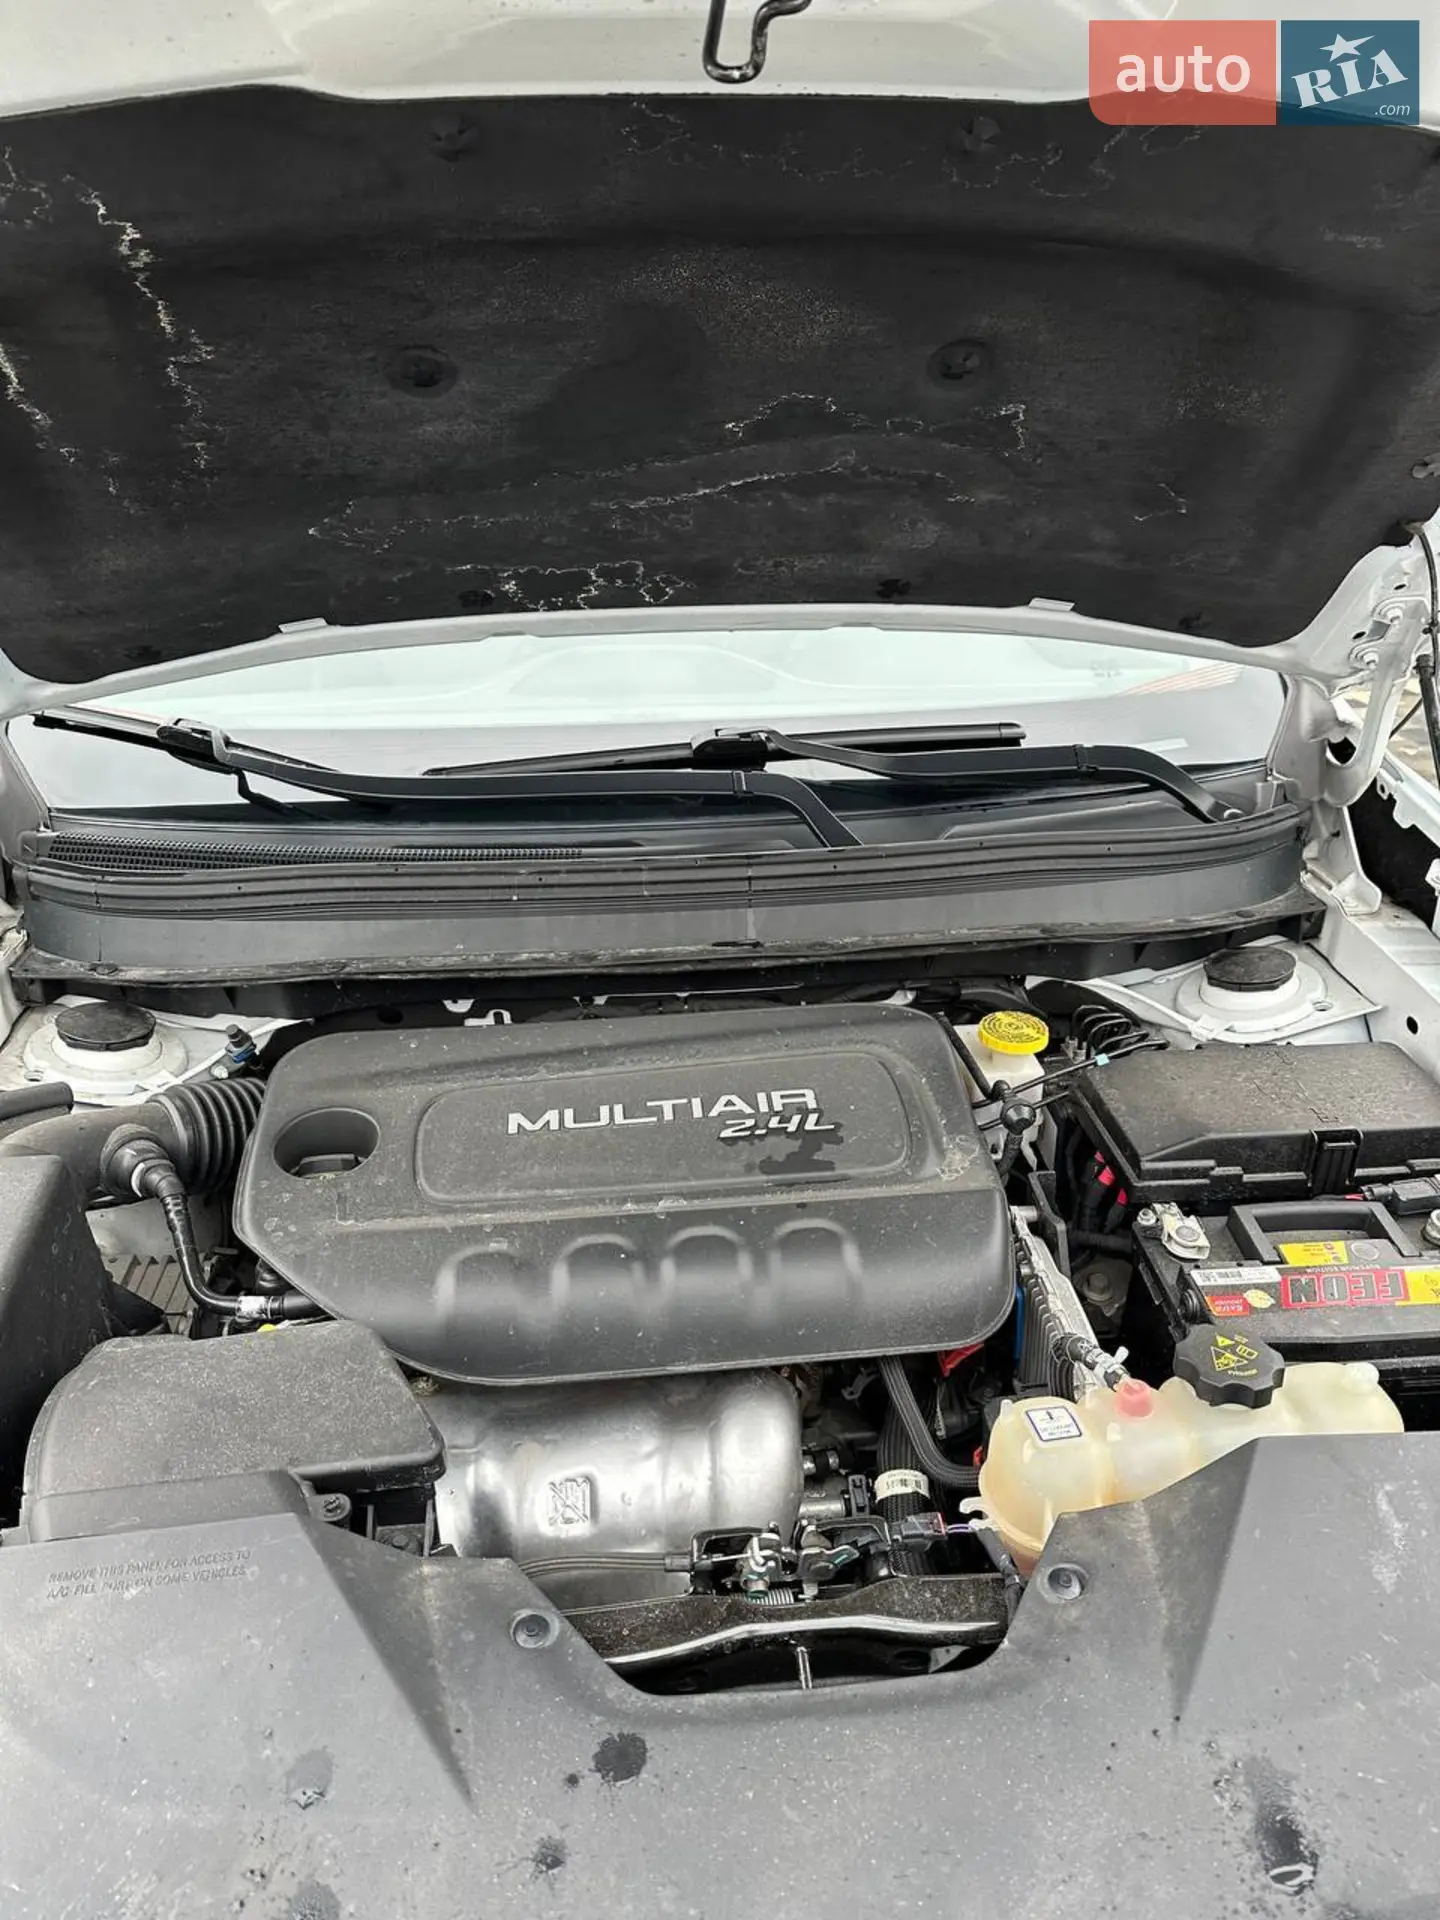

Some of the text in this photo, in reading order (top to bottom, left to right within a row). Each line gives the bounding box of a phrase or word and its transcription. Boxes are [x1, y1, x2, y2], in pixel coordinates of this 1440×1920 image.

[507, 1088, 817, 1135] MULTIAIR
[719, 1112, 835, 1138] 2.4L
[1288, 1271, 1406, 1305] FEON
[189, 1551, 233, 1567] ACCESS
[236, 1549, 252, 1561] TO
[192, 1567, 248, 1582] VEHICLES
